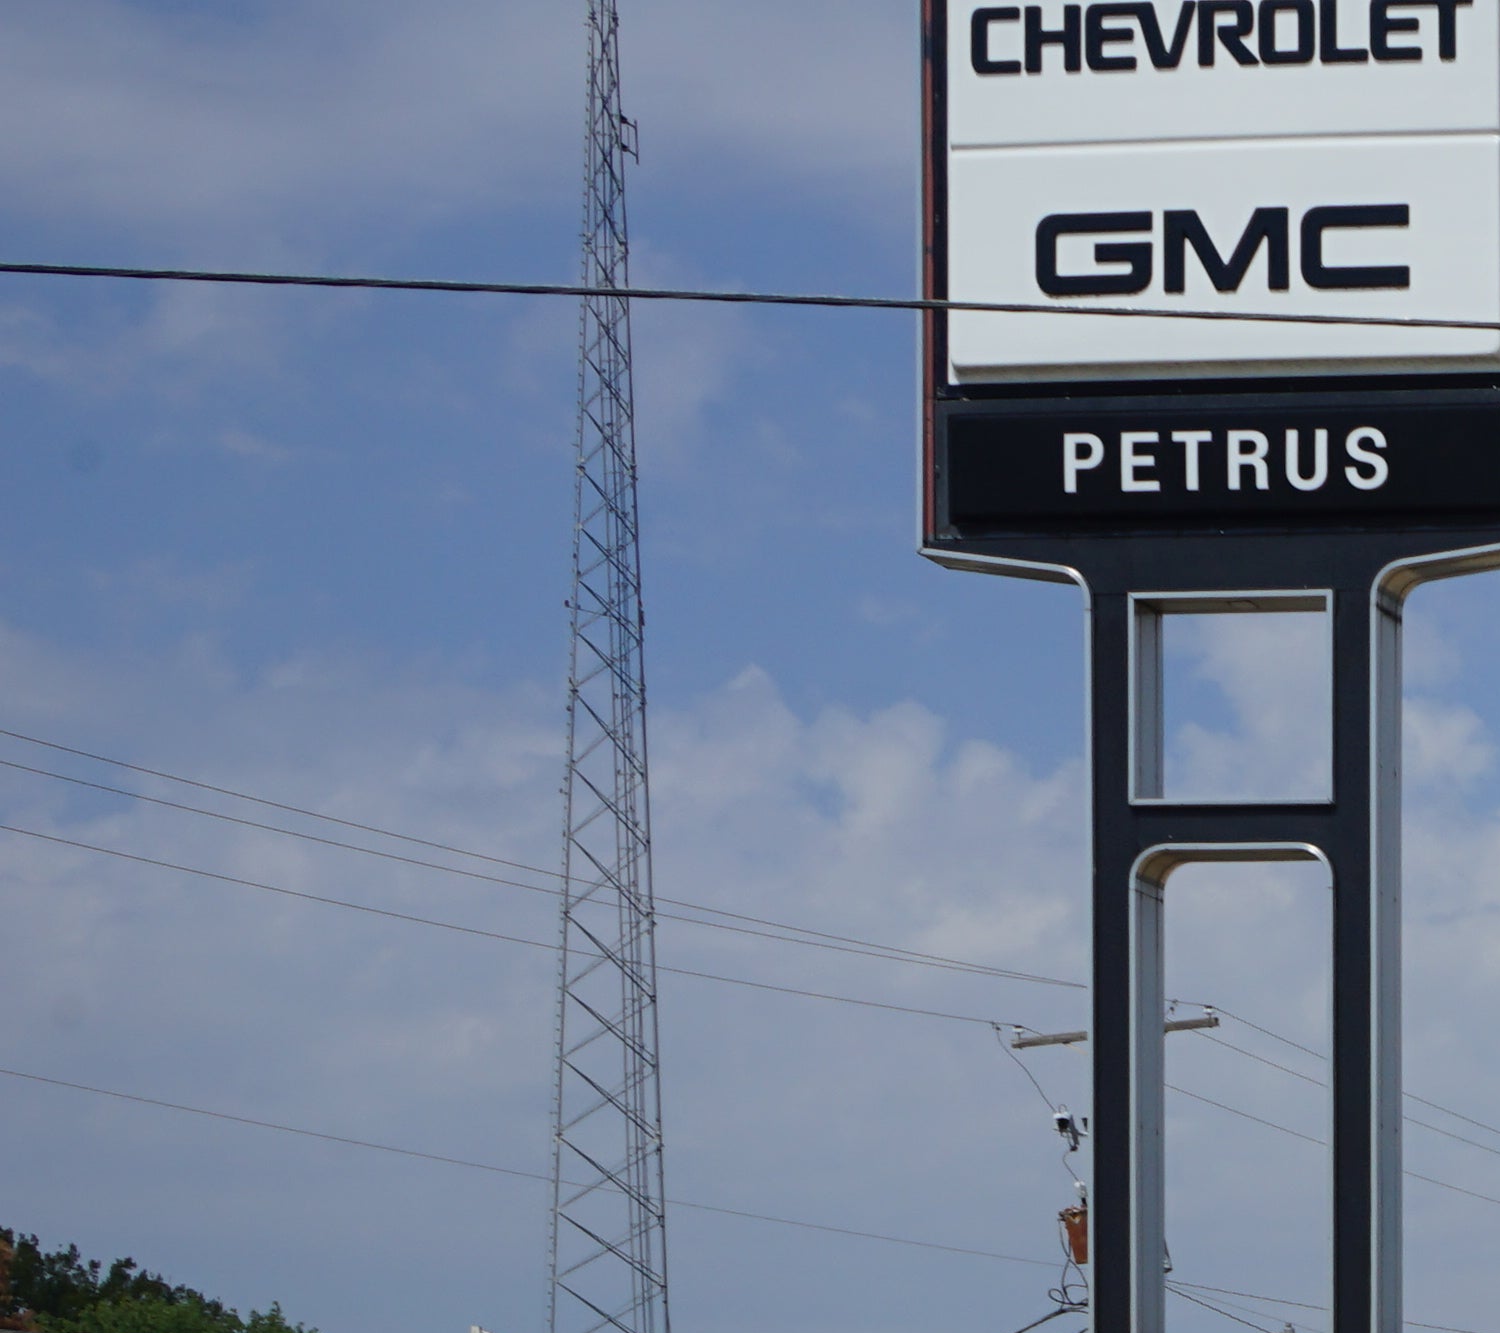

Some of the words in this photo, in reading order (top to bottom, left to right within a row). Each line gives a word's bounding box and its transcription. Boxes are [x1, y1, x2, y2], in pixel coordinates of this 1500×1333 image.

[971, 0, 1474, 75] CHEVROLET
[1035, 203, 1411, 297] GMC
[1062, 426, 1390, 494] PETRUS
